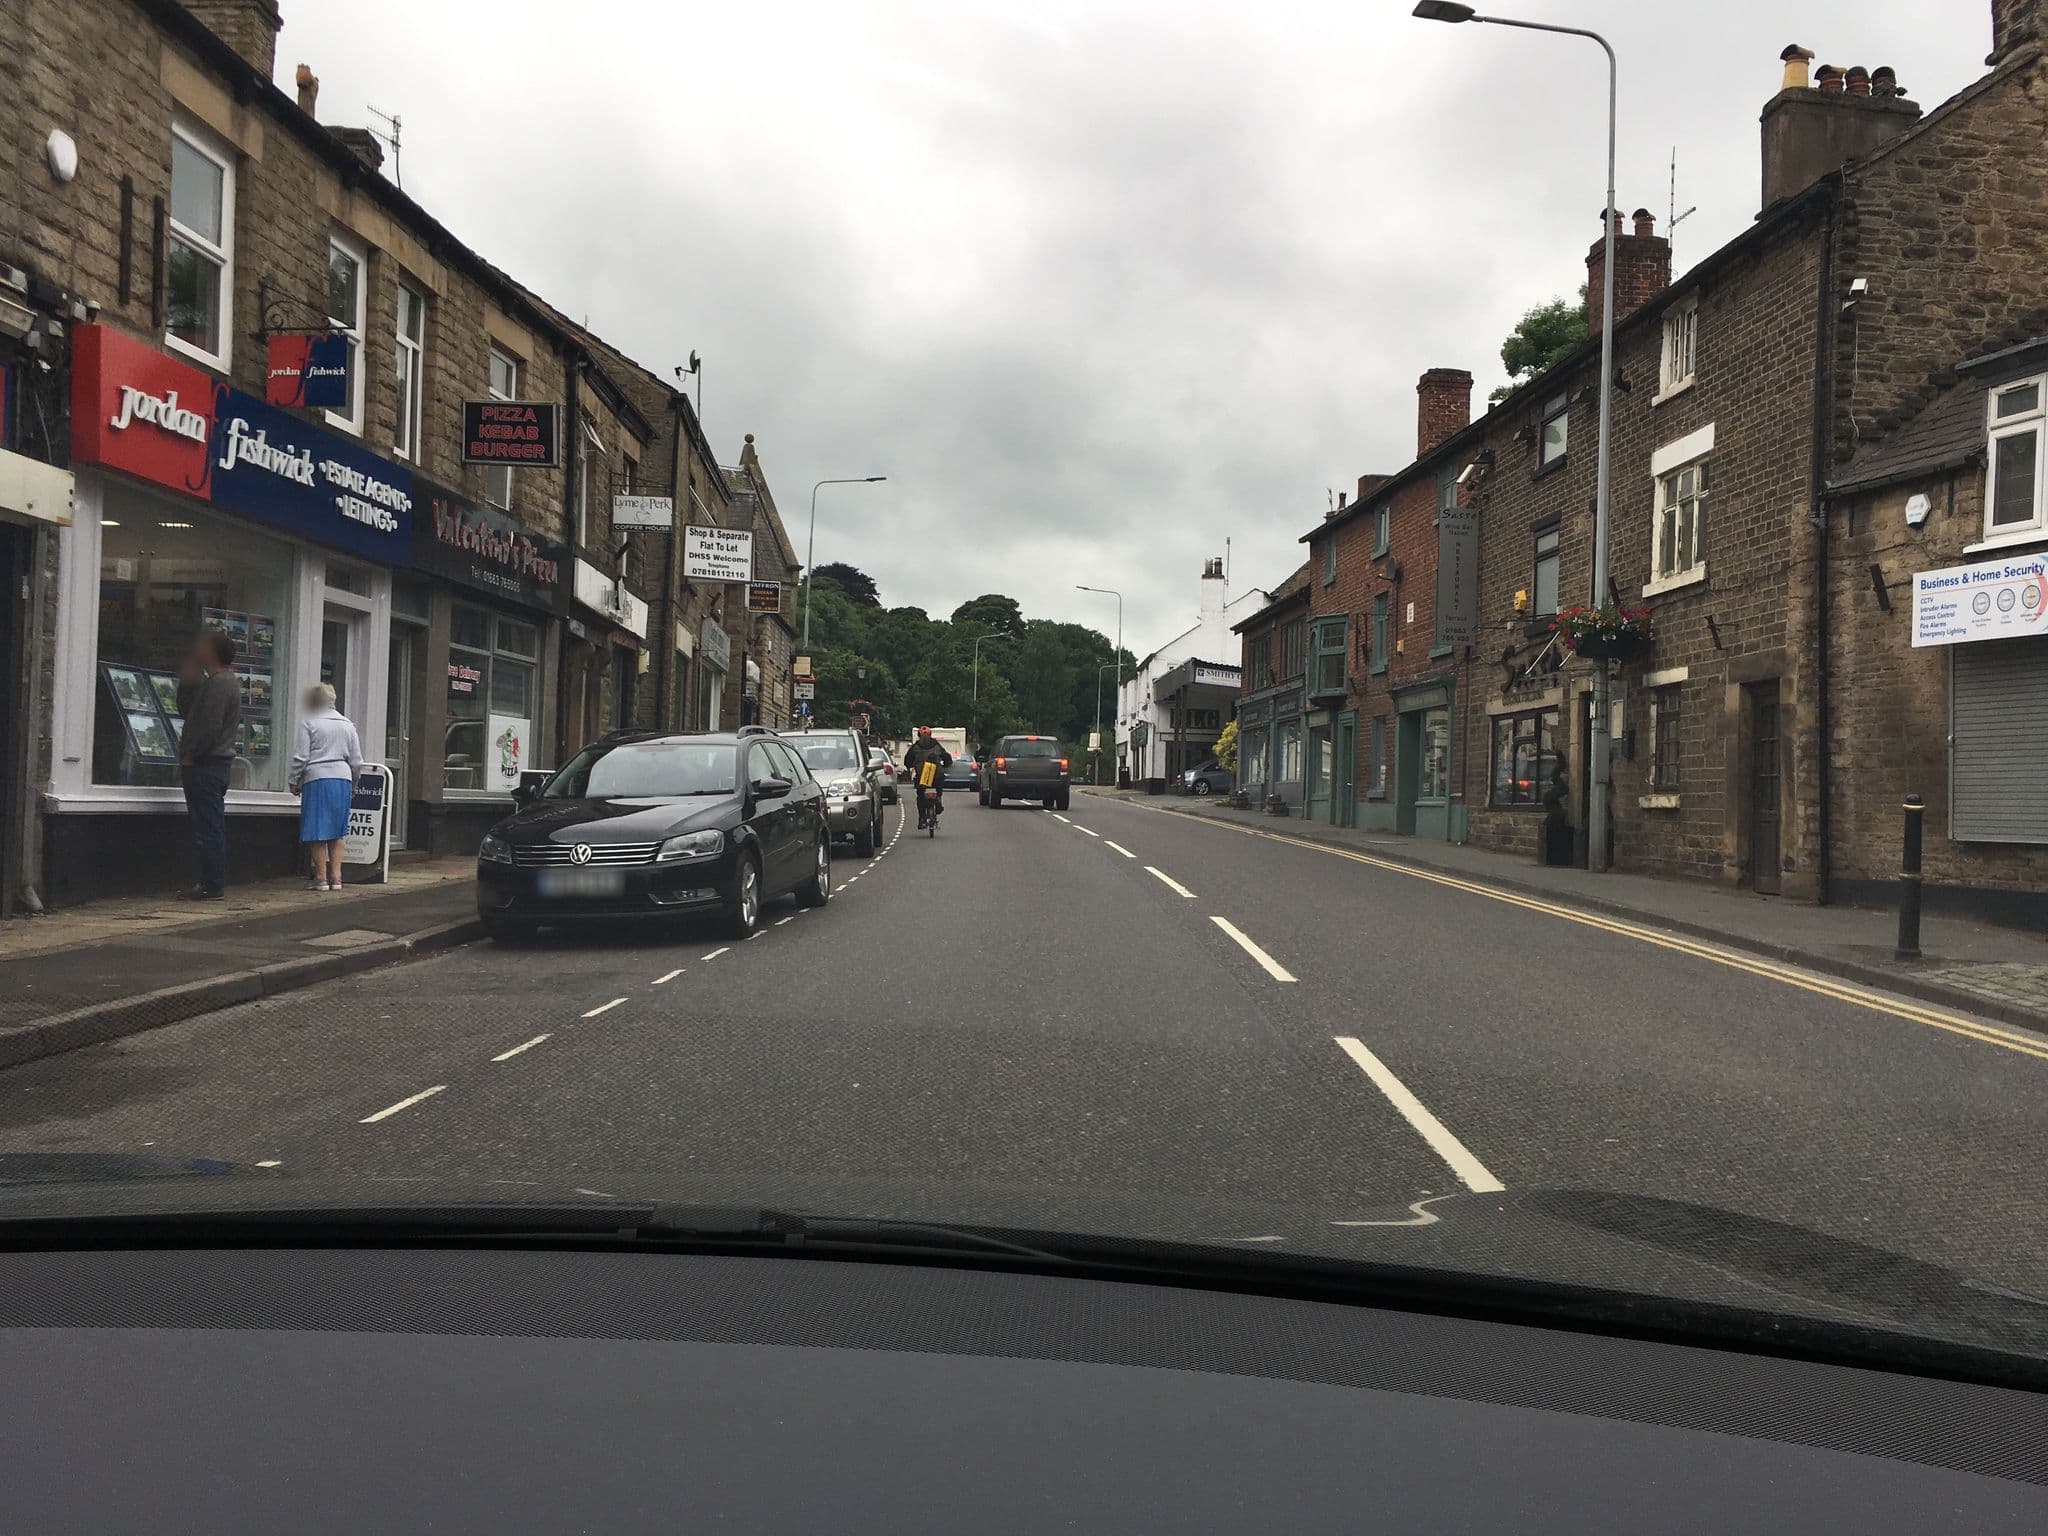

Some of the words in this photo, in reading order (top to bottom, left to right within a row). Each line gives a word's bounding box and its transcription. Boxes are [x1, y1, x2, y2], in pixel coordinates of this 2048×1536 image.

[267, 366, 300, 379] jordan
[306, 366, 346, 379] fishwick
[481, 406, 537, 422] PIZZA
[110, 385, 207, 443] jordan
[219, 418, 316, 487] fishwick
[478, 423, 539, 441] KEBAB
[470, 441, 546, 459] BURGER
[326, 460, 366, 494] ESTATE
[365, 476, 407, 512] AGENTS
[614, 497, 639, 510] Lyme
[650, 498, 671, 510] Perk
[342, 494, 392, 532] LETTINGS
[689, 528, 707, 539] Shop
[709, 530, 714, 538] &
[717, 530, 749, 541] Separate
[700, 541, 714, 550] Flat
[716, 542, 724, 551] To
[726, 544, 738, 552] Let
[688, 552, 711, 560] DHSS
[713, 554, 749, 563] Welcome
[1920, 576, 1959, 590] Business
[1961, 573, 1970, 584] &
[1972, 570, 2001, 583] Home
[2004, 562, 2045, 578] Security
[1920, 597, 1934, 605] CCTV
[1920, 605, 1940, 613] Intruder
[1937, 611, 1955, 619] Control
[1946, 627, 1967, 636] Lighting
[1206, 670, 1234, 679] SMITHY
[502, 764, 518, 776] PIZZA
[349, 812, 372, 824] ATE
[346, 826, 374, 837] NTS
